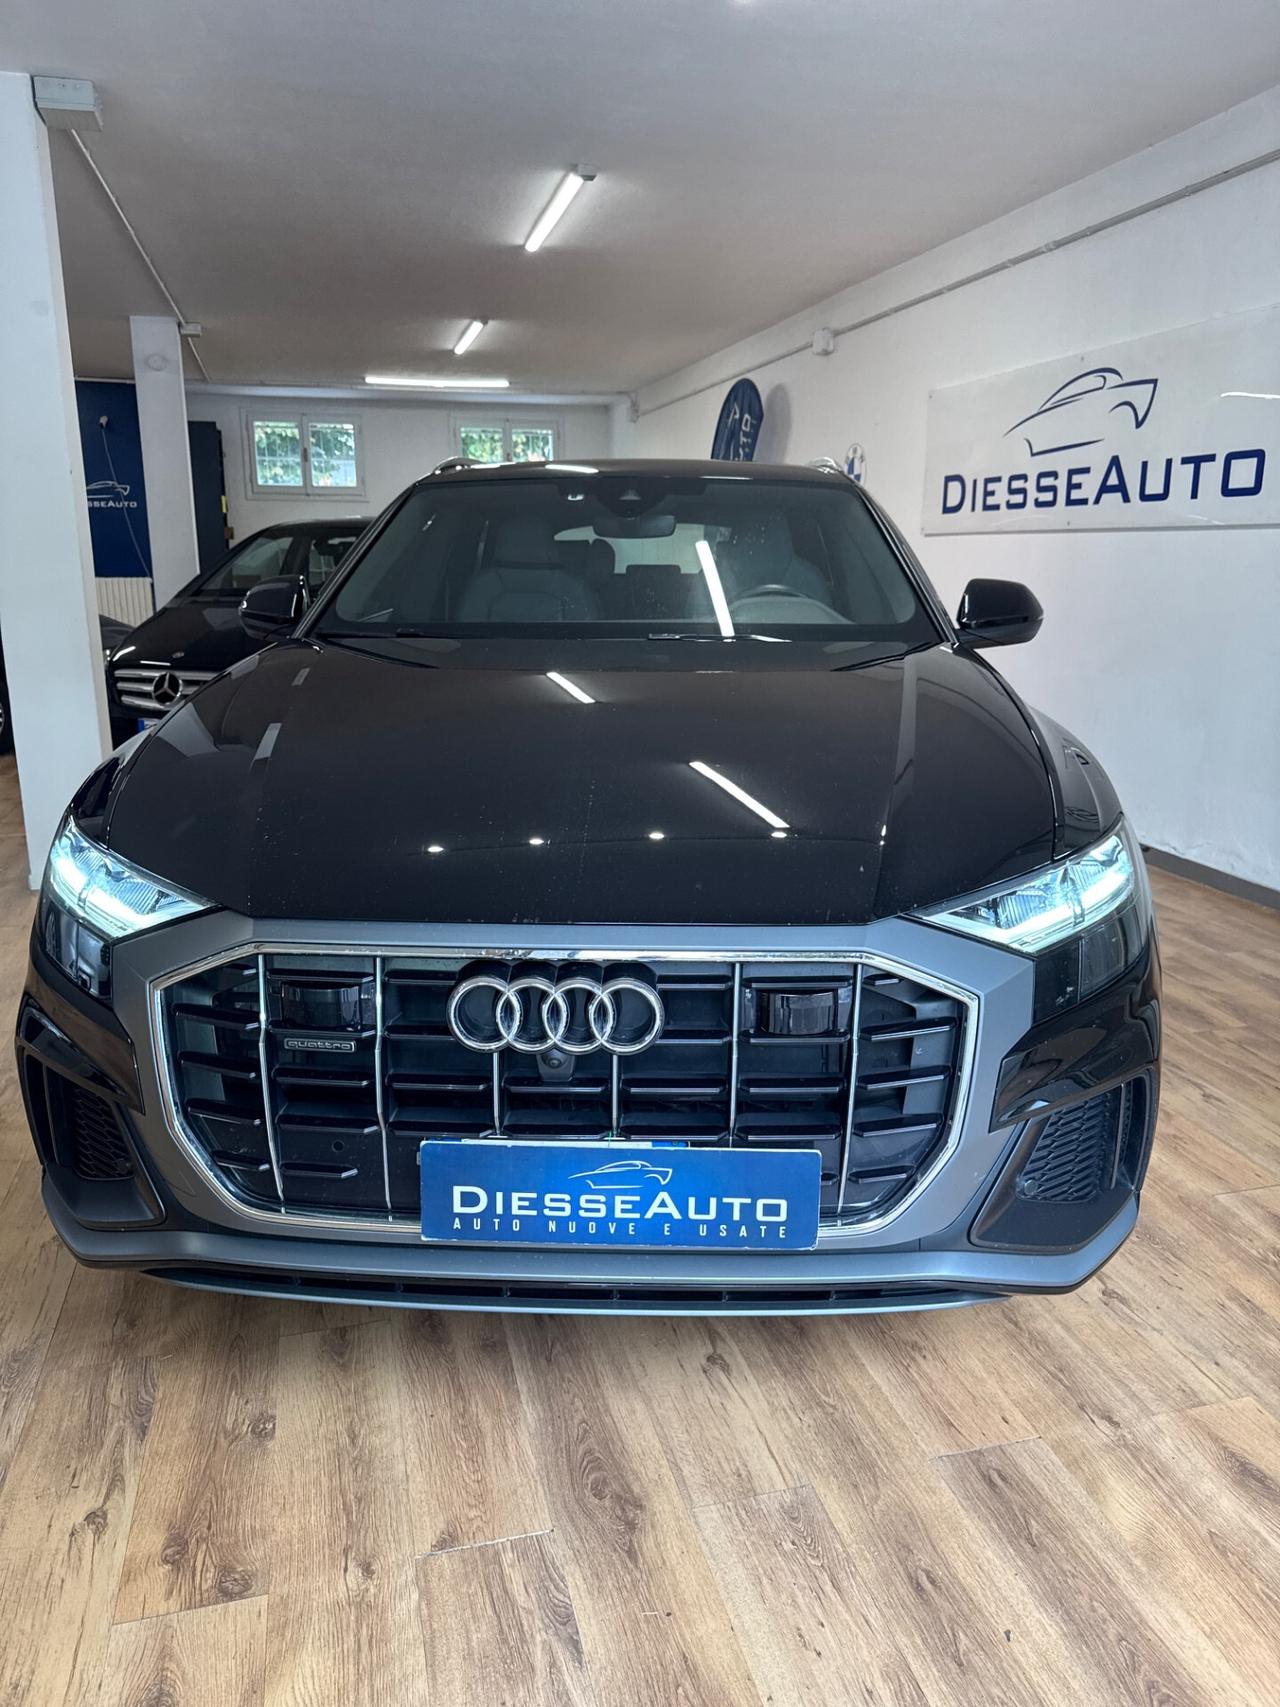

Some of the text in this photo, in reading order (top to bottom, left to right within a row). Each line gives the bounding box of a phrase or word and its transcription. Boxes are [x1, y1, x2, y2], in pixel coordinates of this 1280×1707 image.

[942, 449, 1266, 514] DIESSEAUTO
[288, 1040, 350, 1050] quattro
[452, 1185, 788, 1221] DIESSEAUTO
[453, 1217, 787, 1238] AUTO NUOVE E USATE
